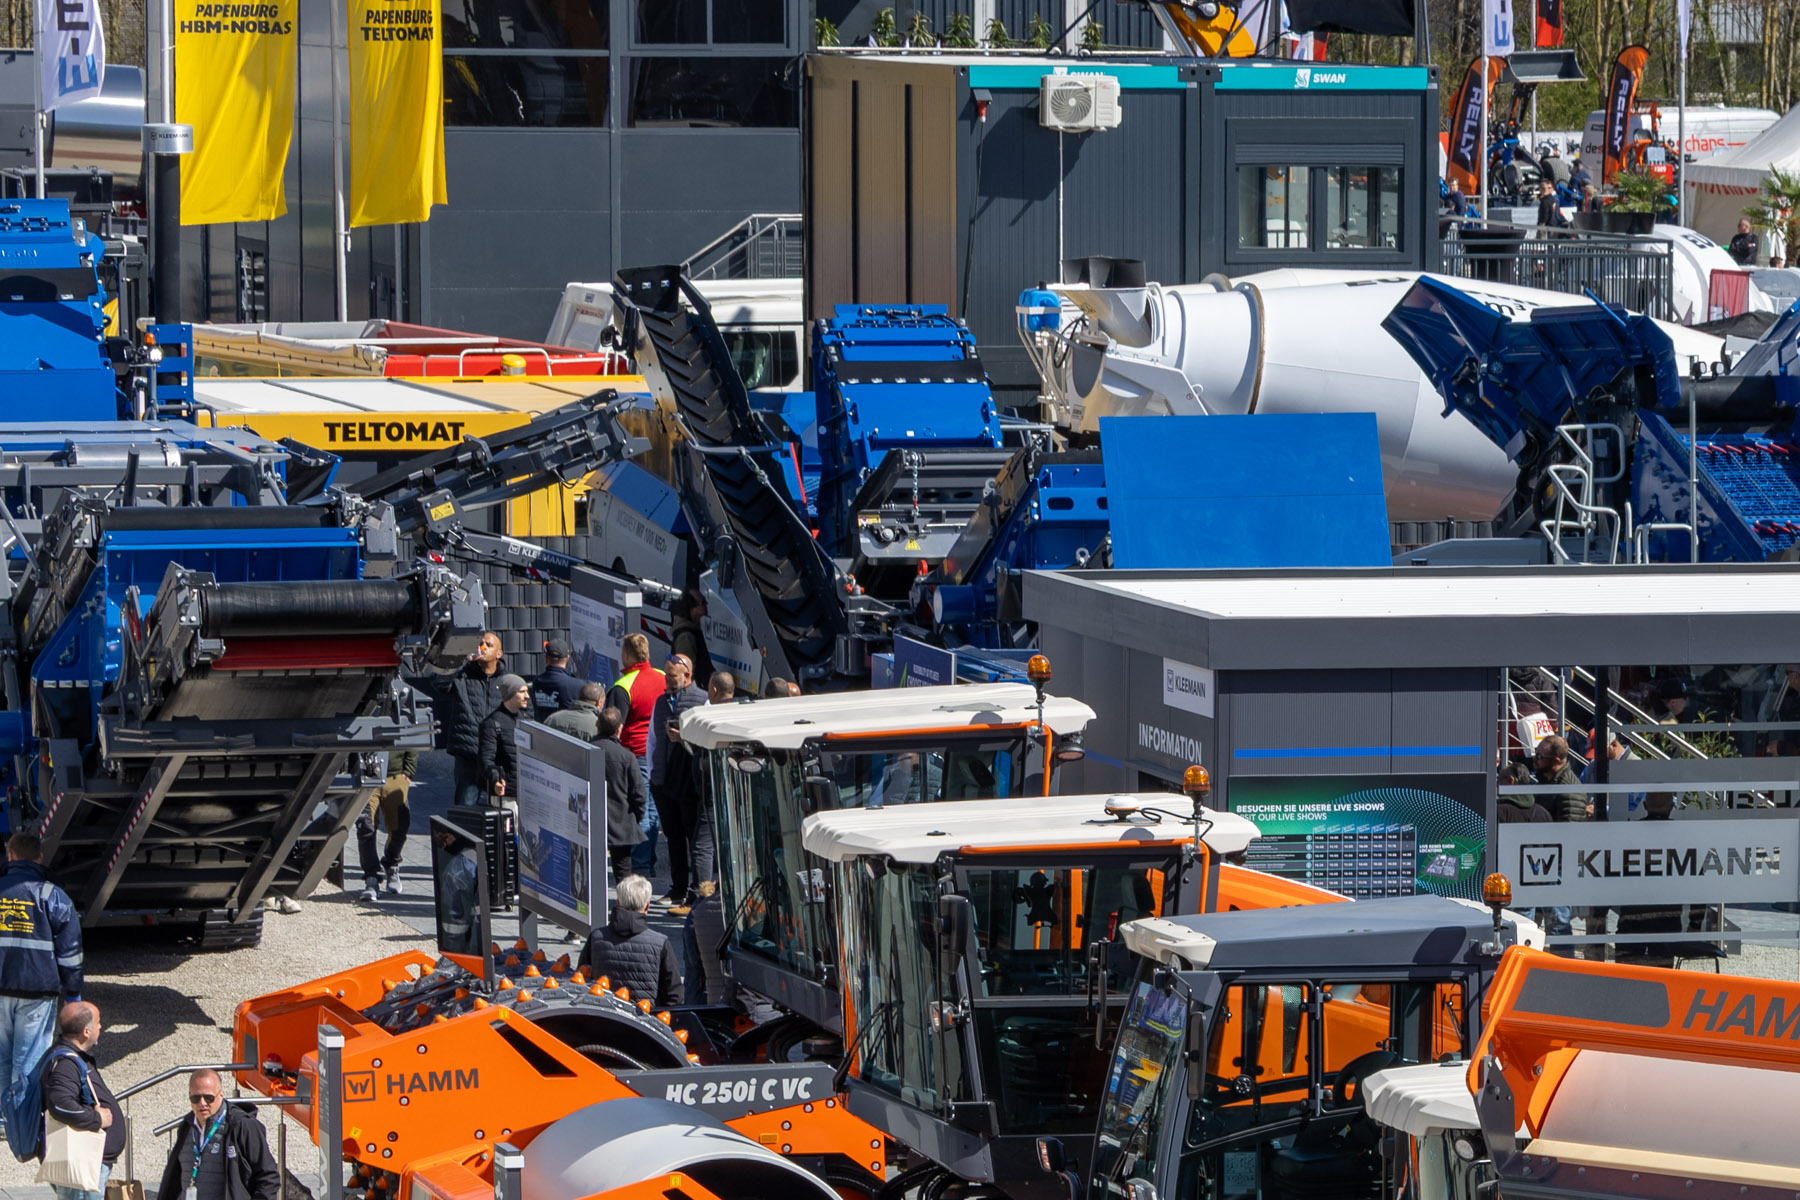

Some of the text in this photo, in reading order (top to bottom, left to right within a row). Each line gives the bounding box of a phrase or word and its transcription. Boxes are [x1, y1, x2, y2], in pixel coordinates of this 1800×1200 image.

[195, 4, 279, 19] PAPENBURG
[365, 9, 433, 25] PAPENBURG
[360, 26, 434, 42] TELTOMAT
[1313, 73, 1346, 84] SWAN
[1459, 86, 1482, 161] RELLY
[1613, 78, 1629, 152] RELLY
[158, 132, 189, 140] KLEEMANN
[324, 420, 466, 443] TELTOMAT
[522, 546, 569, 567] KLEEMANN
[712, 620, 744, 647] KLEEMANN
[1174, 676, 1206, 699] KLEEMANN
[1139, 721, 1202, 765] INFORMATION
[1236, 802, 1385, 813] BESUCHEN SIE UNSERE LIVE SHOWS
[1257, 813, 1276, 821] OUR
[1277, 813, 1295, 821] LIVE
[1296, 812, 1327, 821] SHOWS
[1578, 846, 1780, 879] KLEEMANN
[386, 1068, 480, 1095] HAMM
[666, 1076, 813, 1106] HC 250i C VC
